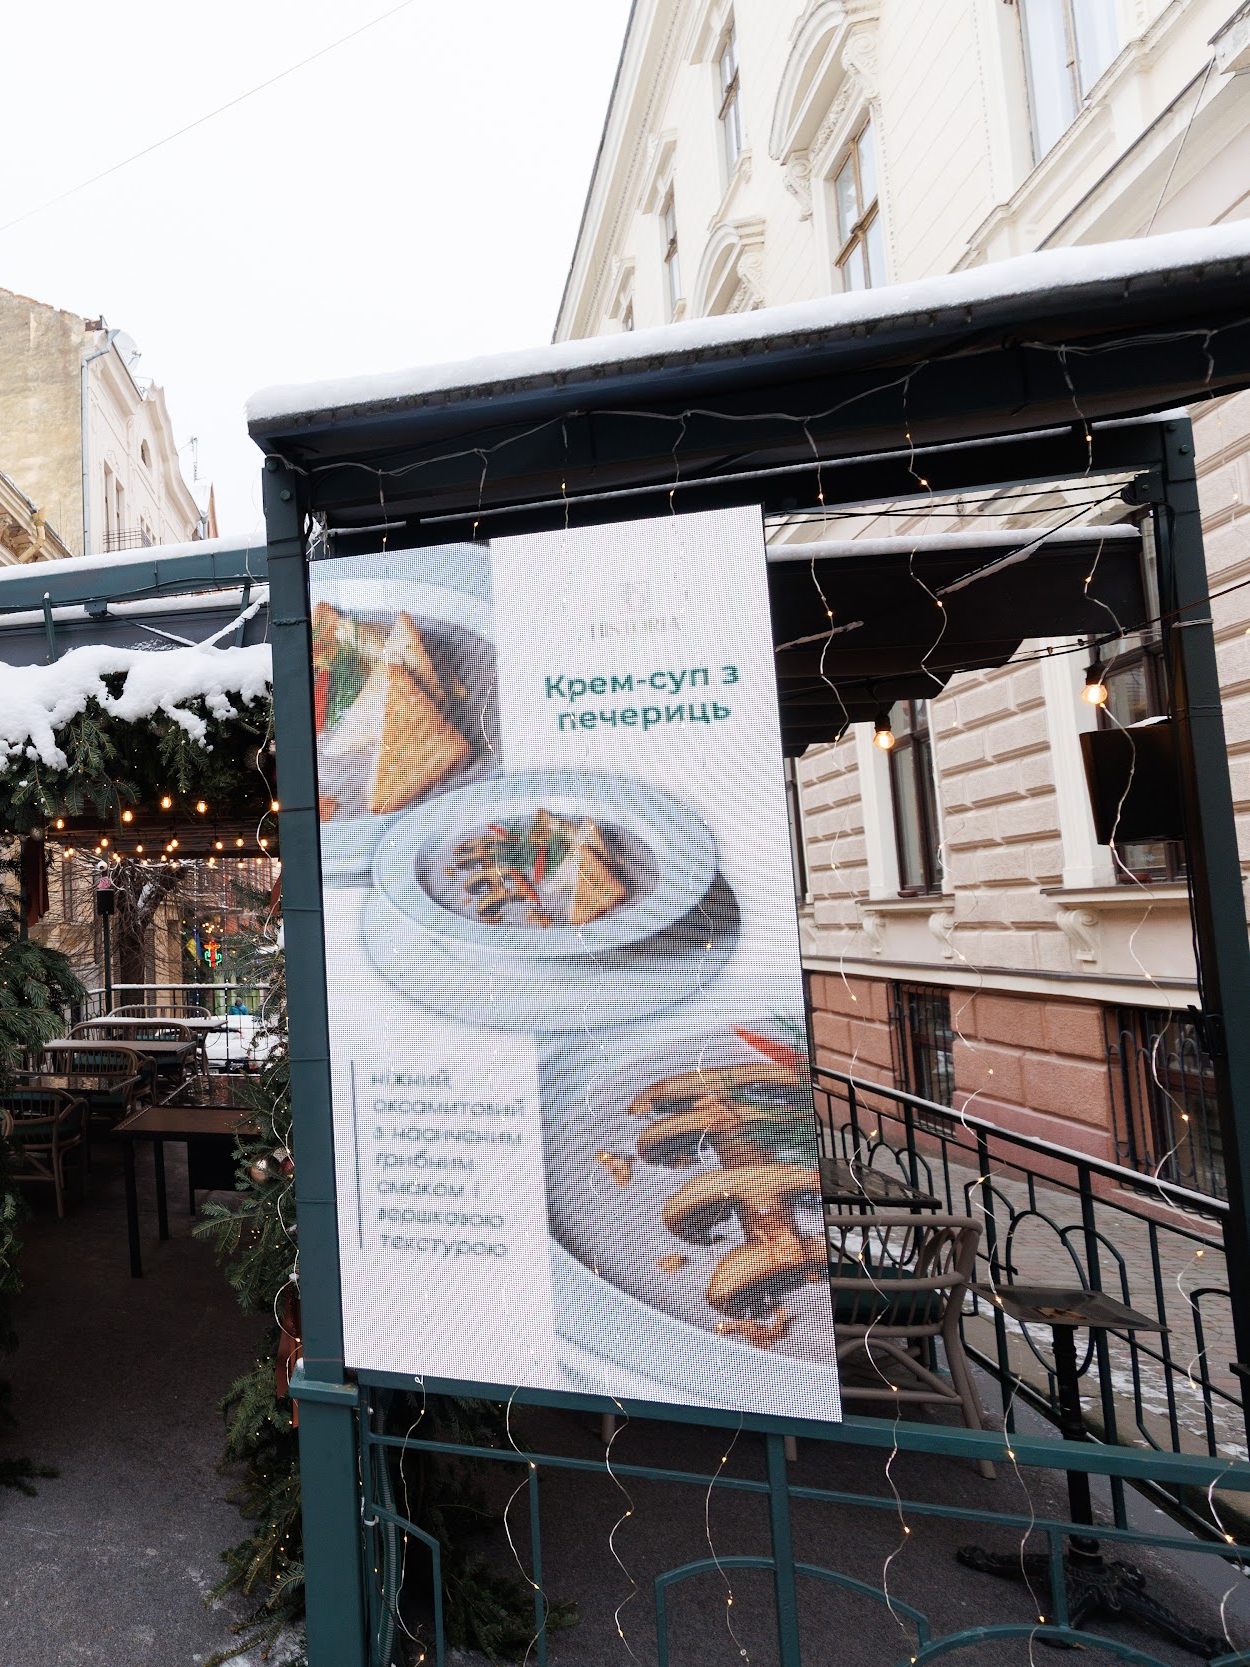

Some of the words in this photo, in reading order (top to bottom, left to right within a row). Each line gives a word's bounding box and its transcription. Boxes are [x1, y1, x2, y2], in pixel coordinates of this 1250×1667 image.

[544, 666, 709, 703] Крем-суп
[557, 701, 732, 731] печериць
[380, 1233, 509, 1259] текстурою
